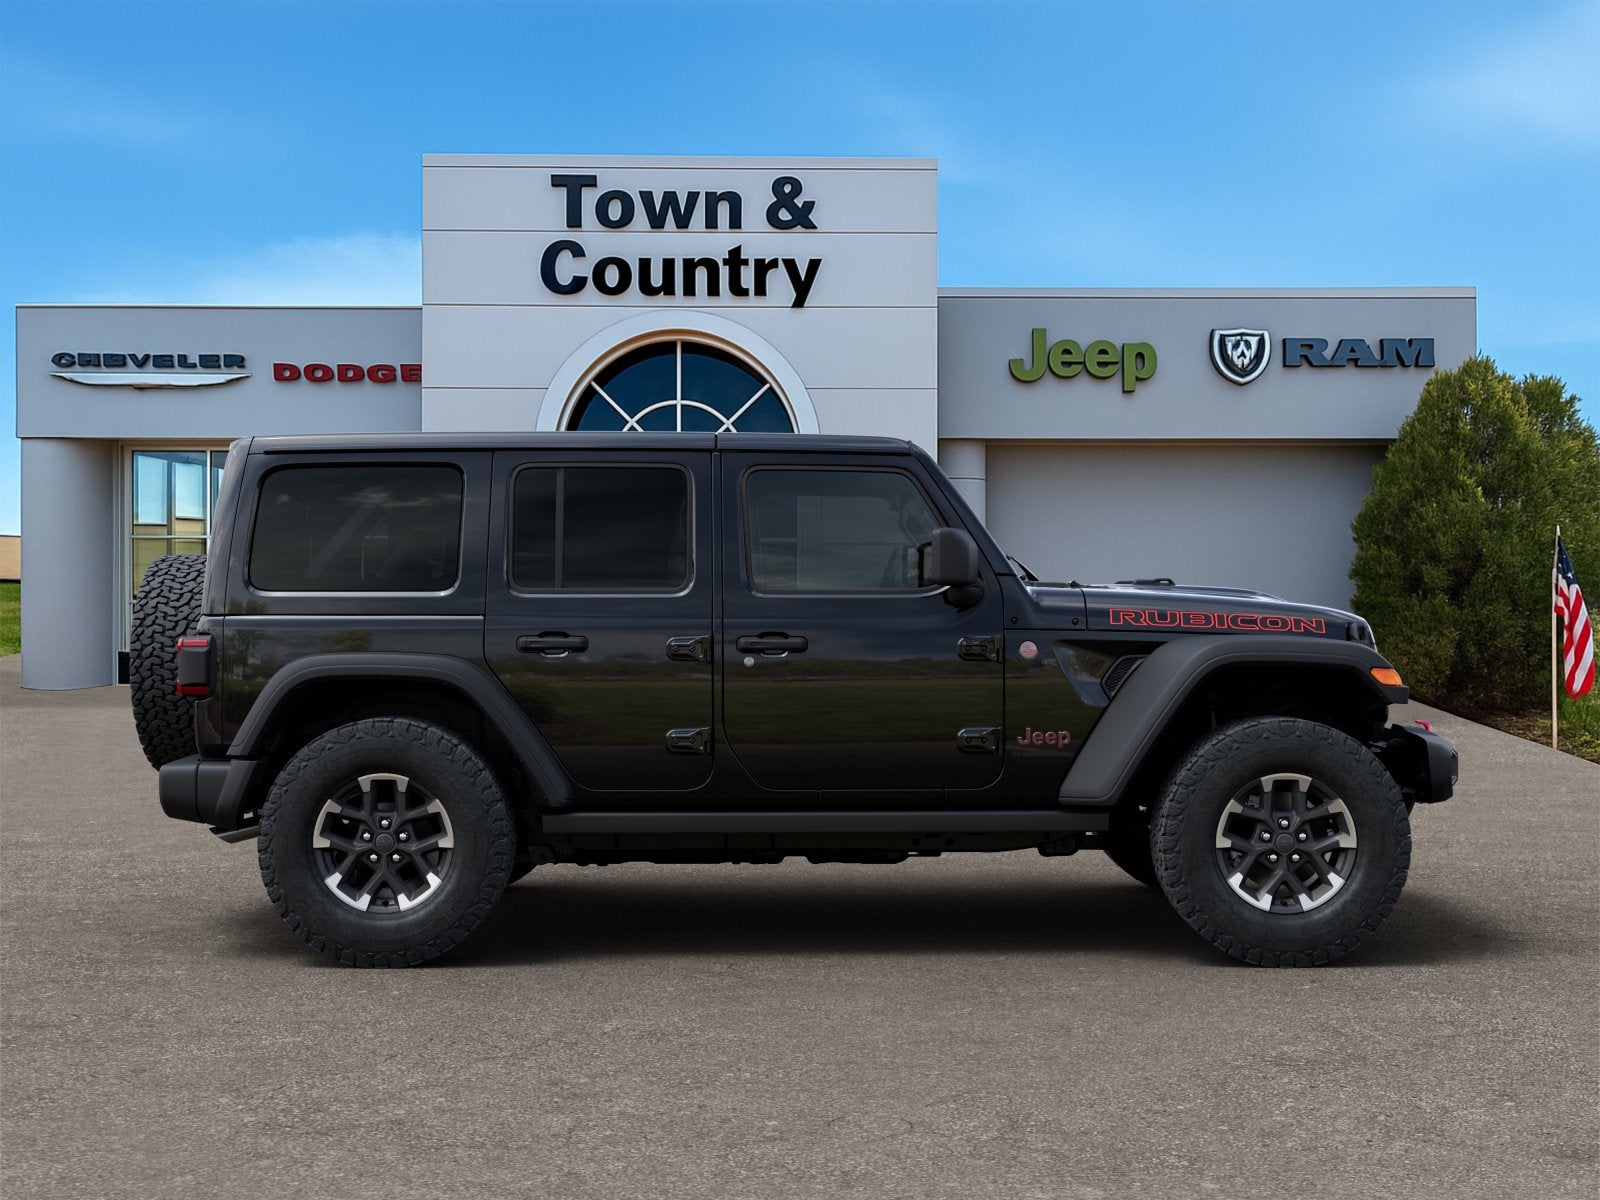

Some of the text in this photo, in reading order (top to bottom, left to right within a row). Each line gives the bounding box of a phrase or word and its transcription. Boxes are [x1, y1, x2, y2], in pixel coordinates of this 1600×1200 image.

[550, 174, 818, 230] Town &
[540, 239, 822, 308] Country
[1008, 328, 1157, 393] Jeep
[1282, 338, 1435, 367] RAM
[272, 362, 422, 383] DODGE
[1109, 608, 1326, 634] RUBICON
[1016, 727, 1072, 749] Jeep
